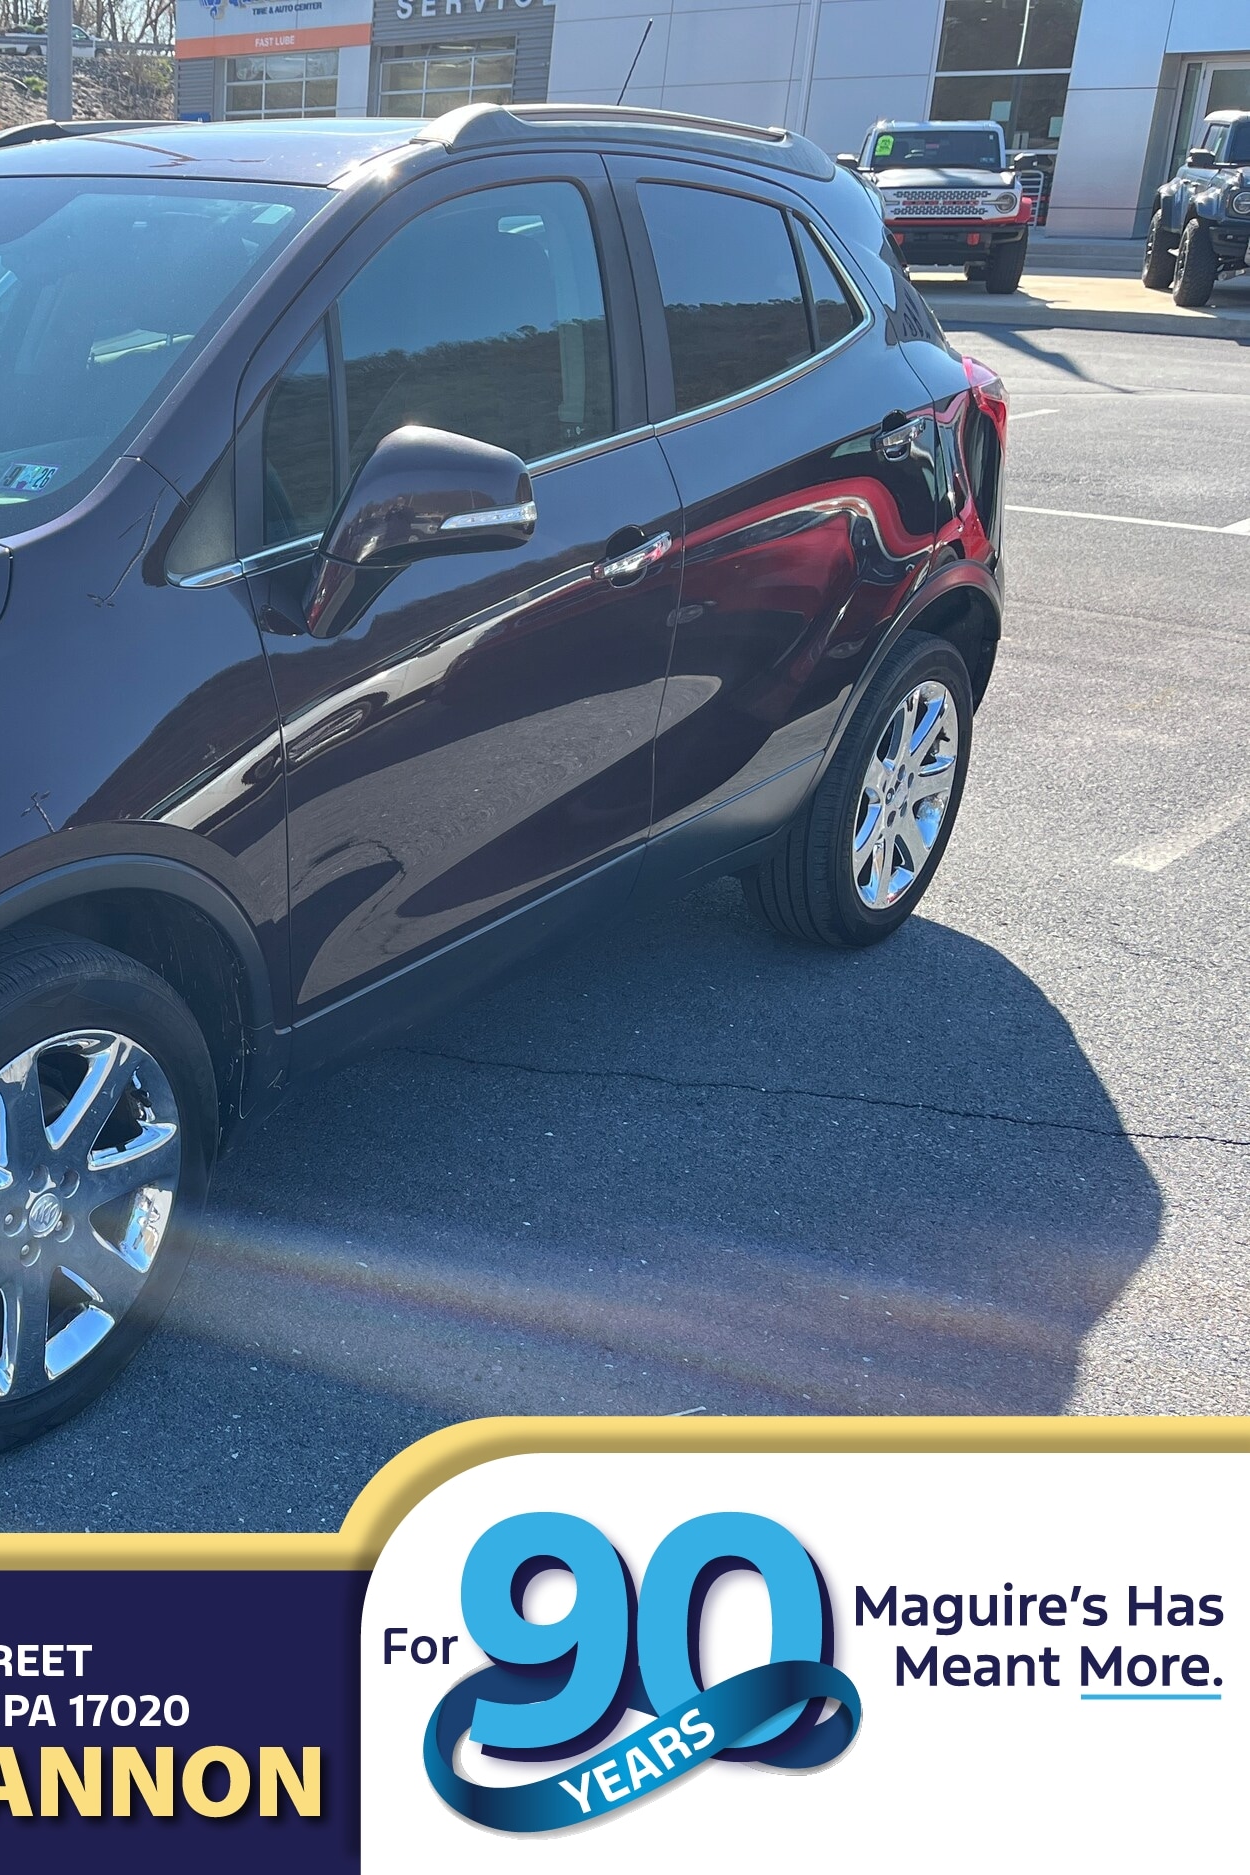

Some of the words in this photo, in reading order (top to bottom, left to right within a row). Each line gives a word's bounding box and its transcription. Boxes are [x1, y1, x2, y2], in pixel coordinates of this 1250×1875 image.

[252, 6, 268, 16] TIRE
[268, 6, 274, 15] &
[274, 5, 294, 14] AUTO
[294, 2, 322, 12] CENTER
[396, 0, 556, 20] SERV
[255, 37, 274, 48] FAST
[275, 35, 295, 46] LUBE
[32, 468, 56, 488] 26
